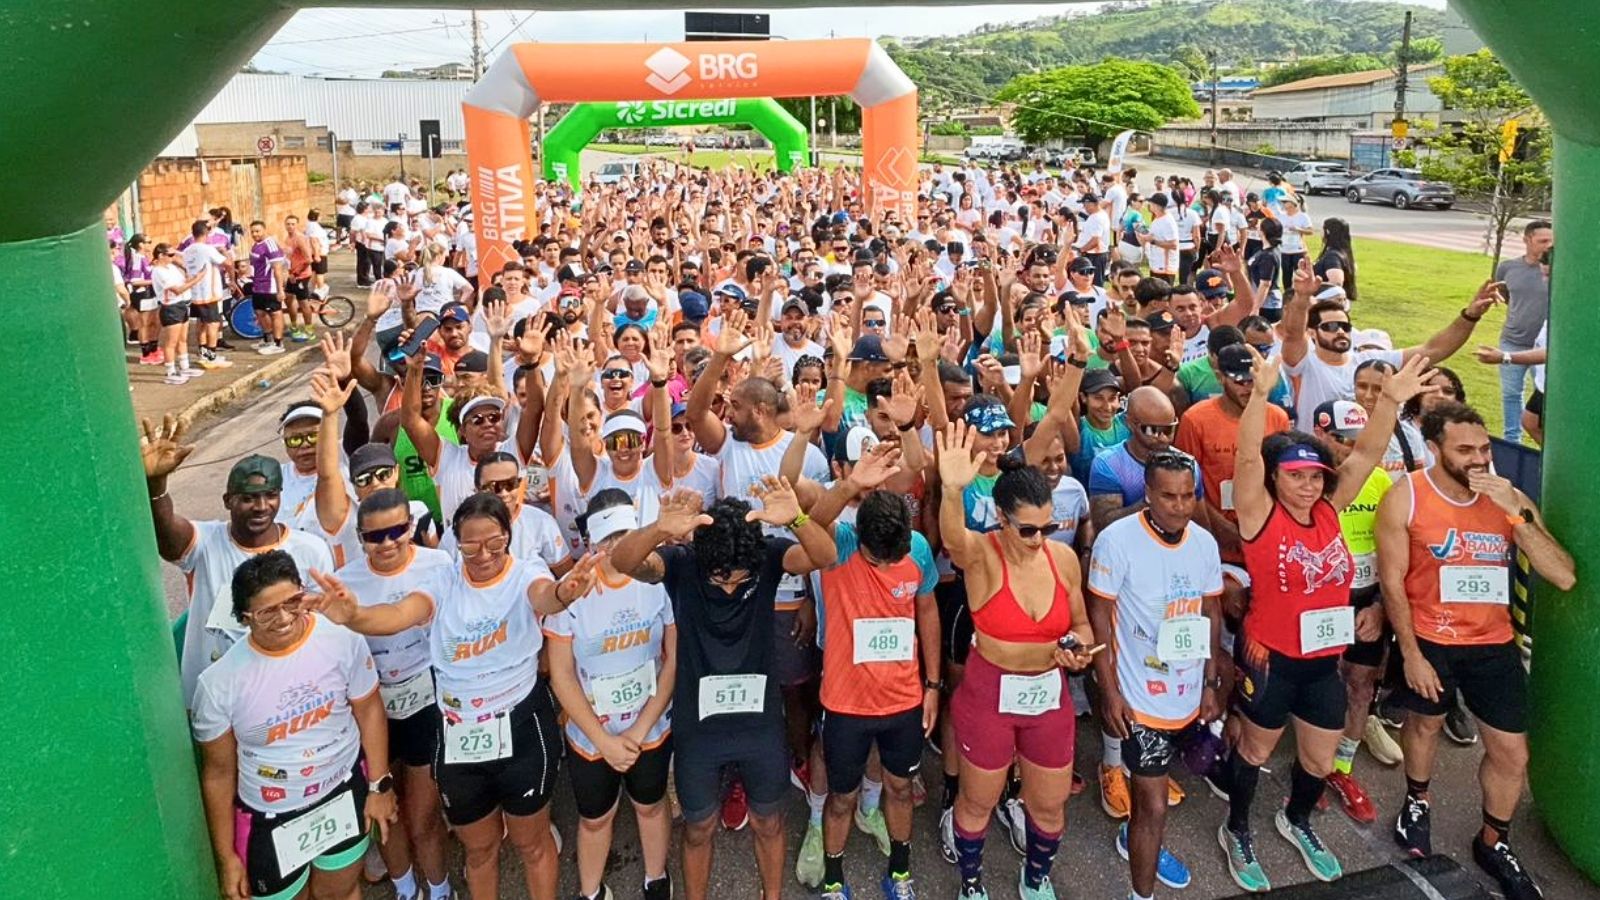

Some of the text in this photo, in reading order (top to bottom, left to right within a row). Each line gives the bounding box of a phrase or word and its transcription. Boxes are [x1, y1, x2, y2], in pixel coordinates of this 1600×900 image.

[699, 52, 758, 81] BRG
[651, 99, 737, 120] Sicredi
[496, 163, 526, 244] ATIVA
[481, 201, 499, 240] BRG
[1456, 580, 1490, 593] 293
[452, 619, 508, 663] RUN
[602, 626, 651, 654] RUN
[1174, 633, 1192, 649] 96
[1316, 624, 1335, 638] 35
[868, 635, 898, 650] 489
[386, 692, 418, 711] 472
[611, 682, 642, 704] 363
[715, 690, 746, 703] 511
[1017, 690, 1048, 705] 272
[265, 700, 336, 746] RUN
[460, 734, 493, 751] 273
[297, 818, 337, 851] 279
